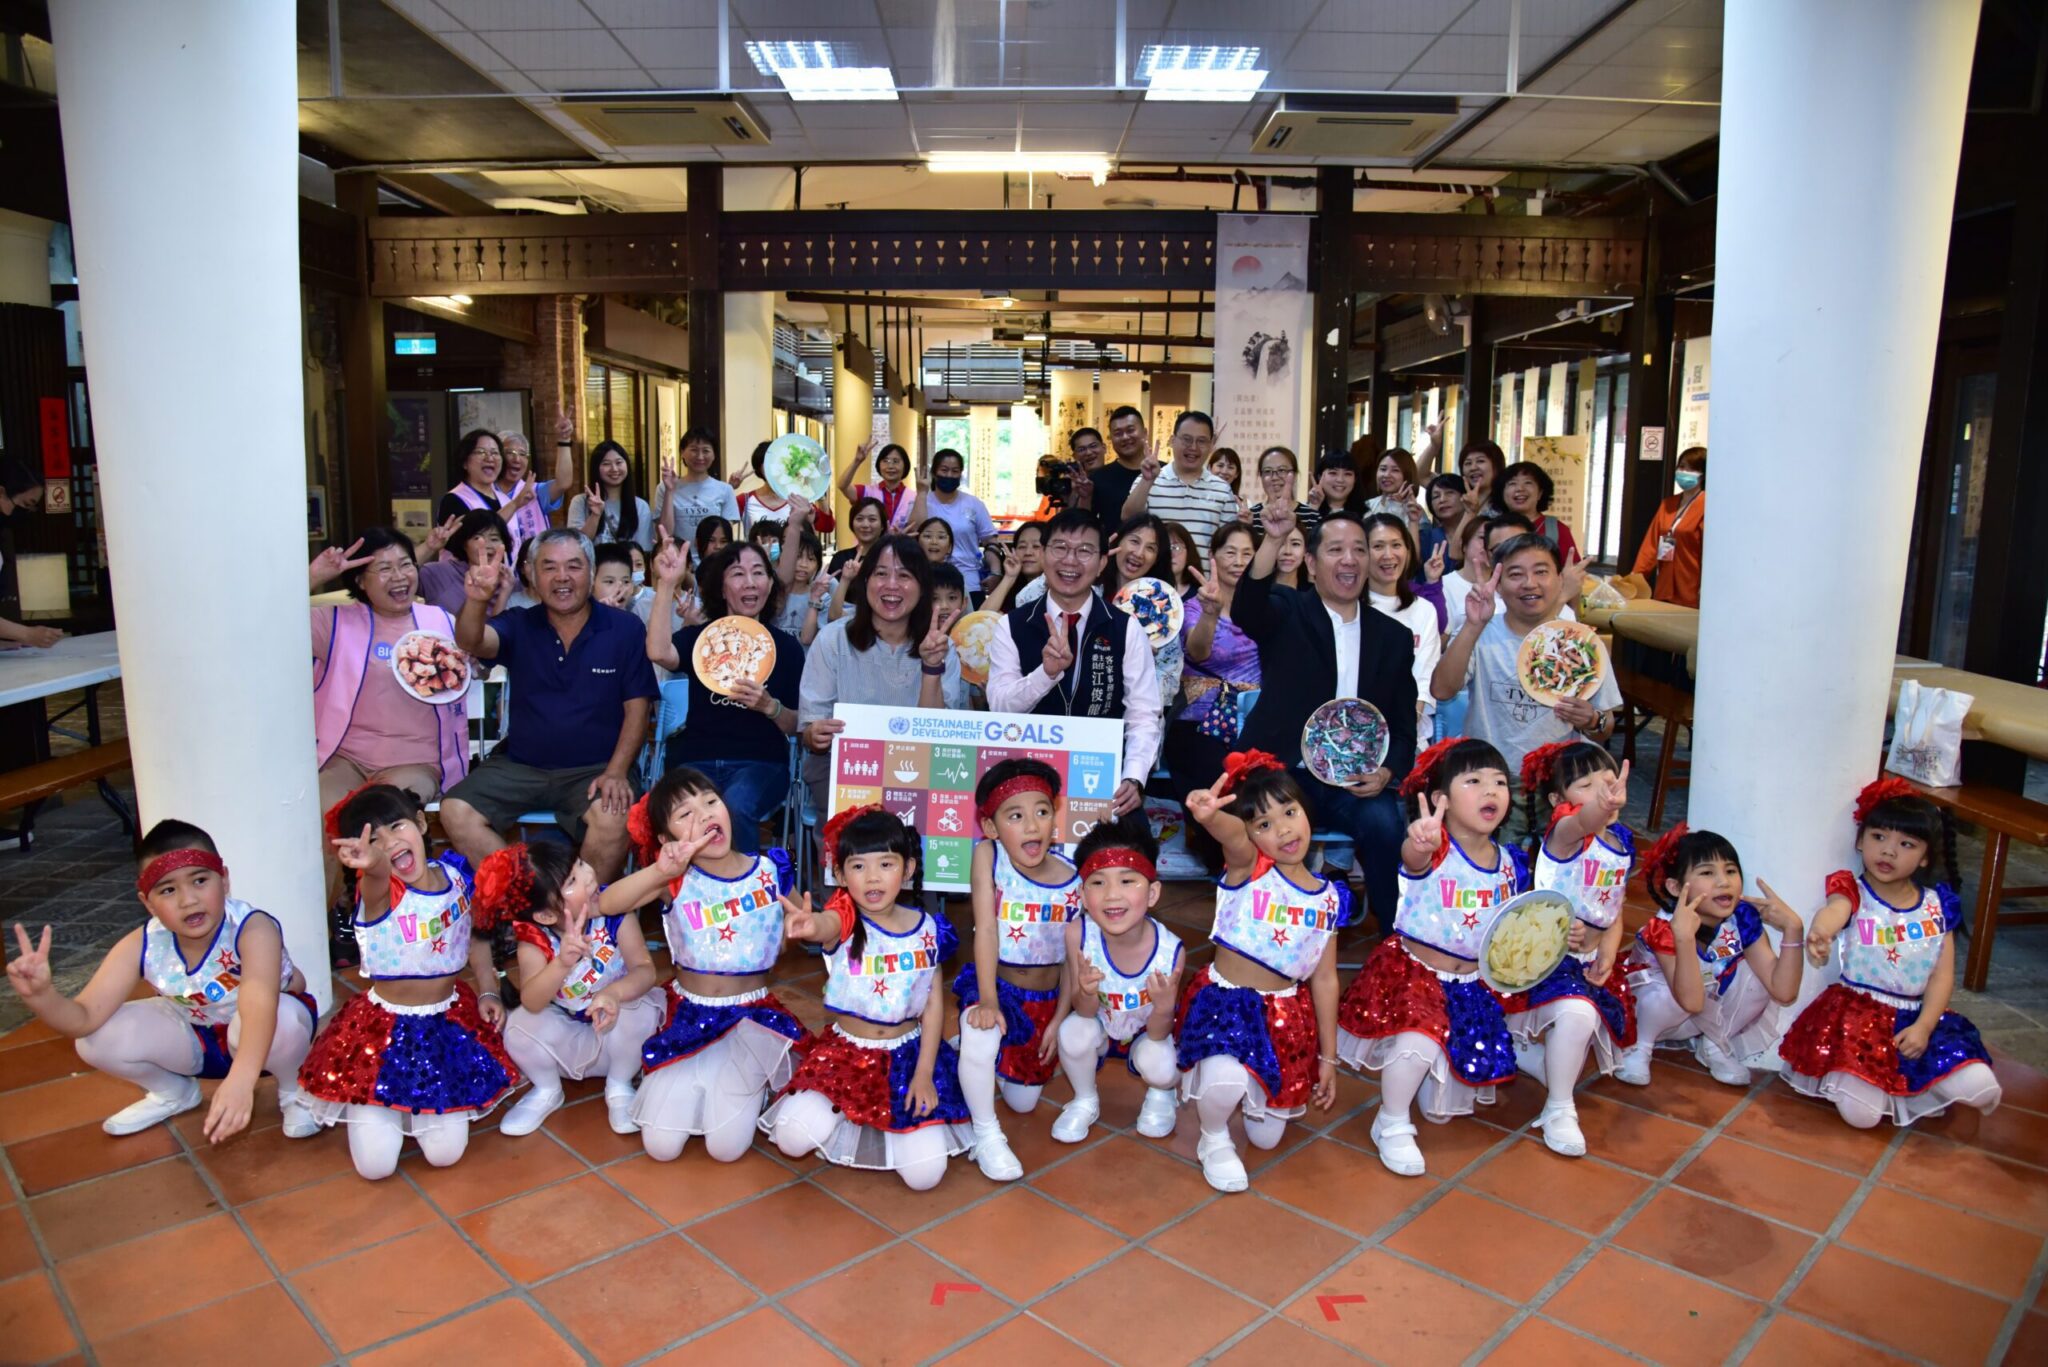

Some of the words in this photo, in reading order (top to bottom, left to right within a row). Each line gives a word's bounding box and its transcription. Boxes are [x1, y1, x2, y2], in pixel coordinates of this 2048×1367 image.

[912, 717, 984, 730] SUSTAINABLE
[911, 727, 983, 740] DEVELOPMENT
[984, 721, 1064, 745] GOALS
[843, 741, 849, 752] 1
[888, 744, 895, 755] 2
[934, 746, 941, 758] 3
[980, 749, 987, 760] 4
[840, 787, 846, 799] 7
[885, 790, 892, 801] 8
[931, 792, 938, 804] 9
[1070, 800, 1079, 812] 12
[929, 839, 938, 850] 15
[682, 884, 778, 931] VICTORY
[1252, 889, 1337, 932] VICTORY
[1856, 916, 1945, 945] VICTORY
